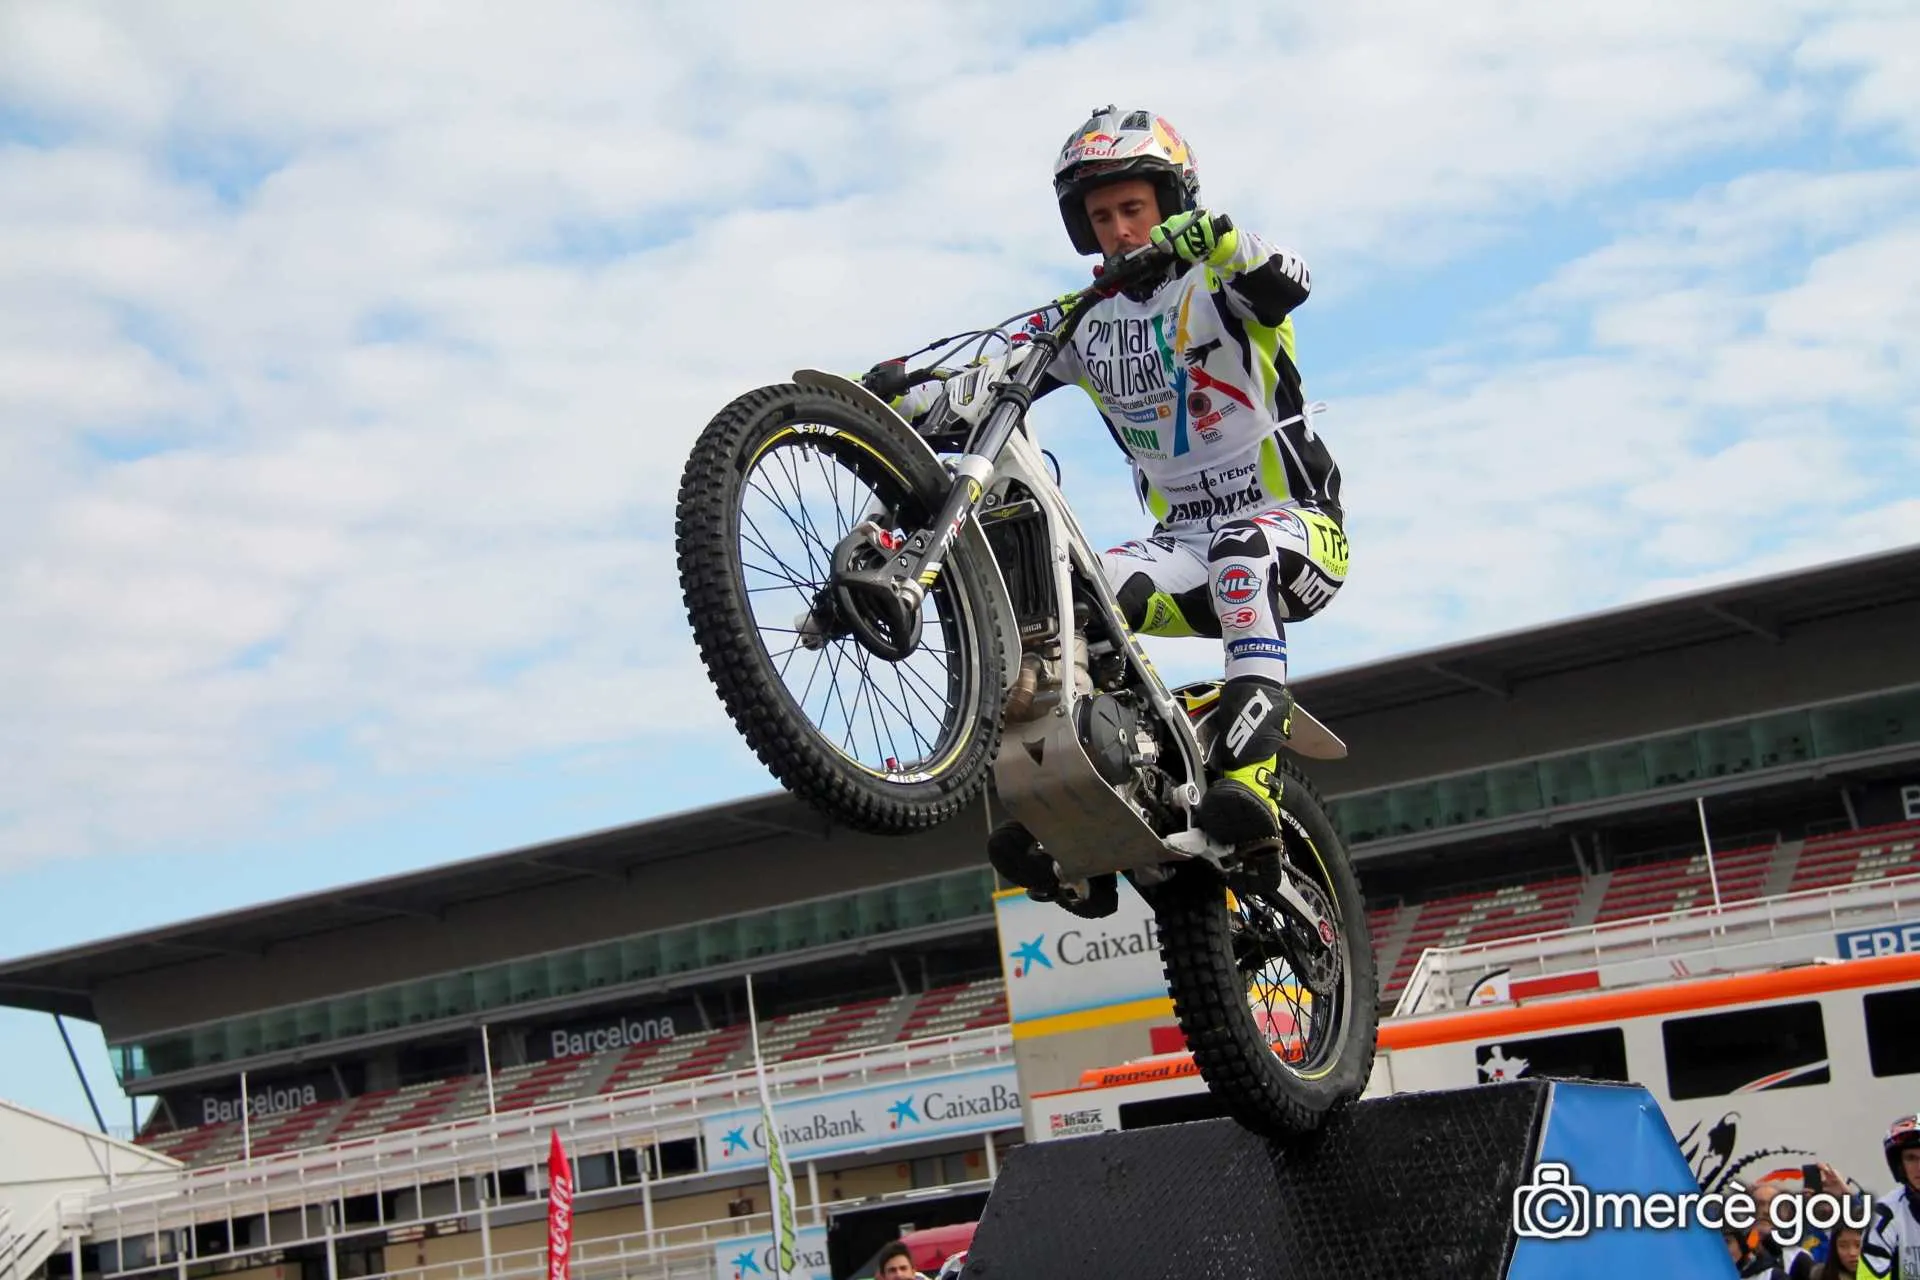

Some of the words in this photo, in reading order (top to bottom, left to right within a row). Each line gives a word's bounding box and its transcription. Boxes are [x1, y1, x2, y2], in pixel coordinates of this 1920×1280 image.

[1084, 147, 1117, 157] Bull
[1219, 463, 1257, 484] l'Ebre
[1216, 577, 1263, 597] NILS
[551, 1015, 676, 1060] Barcelona
[203, 1084, 317, 1123] Barcelona
[752, 1108, 866, 1149] CixaBank
